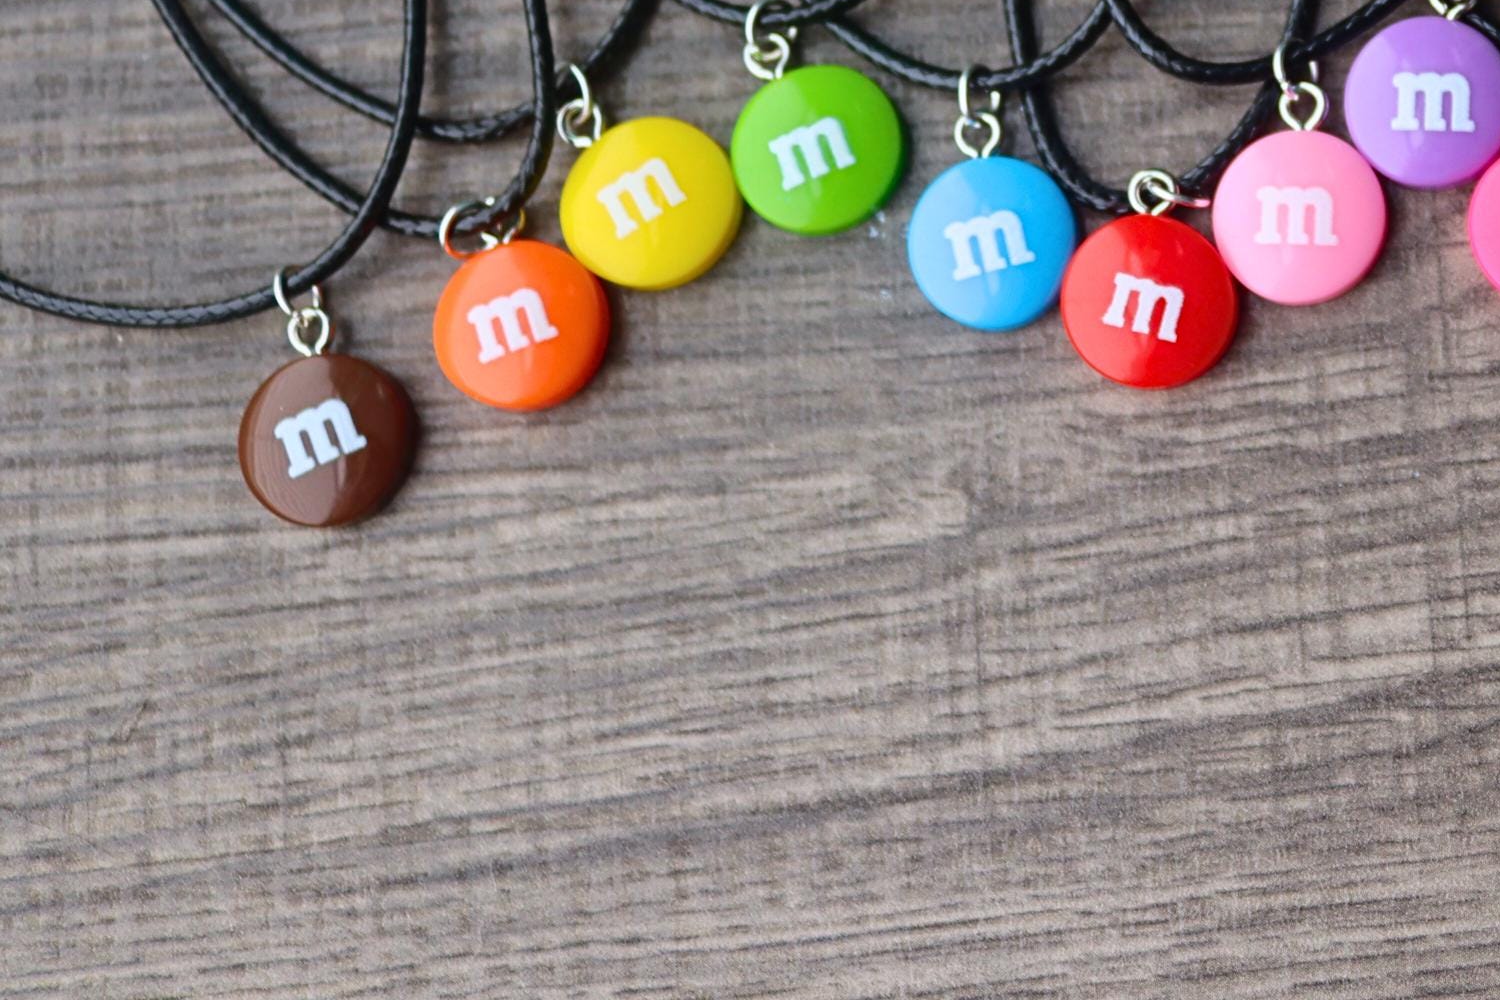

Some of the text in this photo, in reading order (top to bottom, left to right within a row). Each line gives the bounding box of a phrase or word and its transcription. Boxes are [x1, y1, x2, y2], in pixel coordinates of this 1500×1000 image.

[1391, 71, 1475, 132] m
[768, 116, 856, 190] m
[597, 157, 687, 239] m
[1254, 186, 1338, 245] m
[944, 210, 1036, 281] m
[467, 288, 558, 364] m
[1102, 272, 1184, 342] m
[274, 398, 367, 479] m
